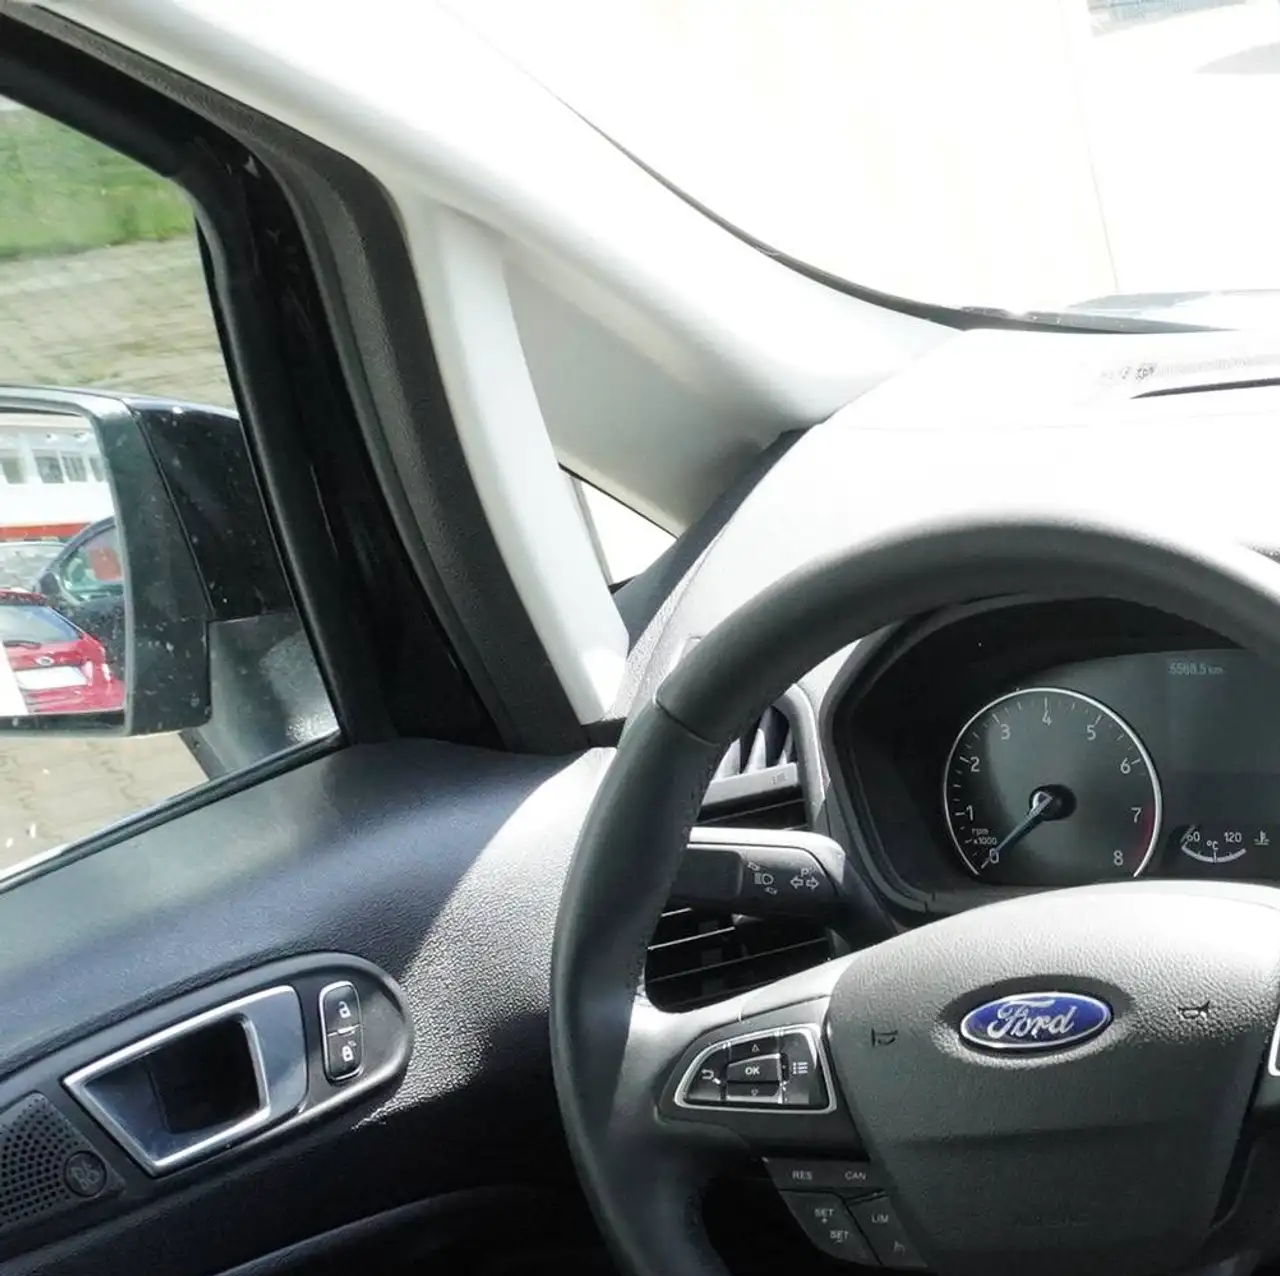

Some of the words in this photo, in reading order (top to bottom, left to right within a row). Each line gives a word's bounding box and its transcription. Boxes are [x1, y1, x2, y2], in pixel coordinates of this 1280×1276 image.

[1042, 710, 1052, 726] 4
[1000, 724, 1011, 739] 3
[1086, 725, 1097, 740] 5
[970, 757, 980, 772] 2
[1120, 760, 1131, 774] 6
[966, 805, 974, 820] 1
[1131, 807, 1142, 822] 7
[1223, 832, 1242, 843] 120
[989, 848, 1000, 864] 0
[1113, 850, 1124, 866] 8
[987, 999, 1078, 1039] Ford
[745, 1066, 760, 1075] OK
[792, 1171, 813, 1180] RES
[844, 1171, 867, 1180] CAN
[814, 1208, 834, 1217] SET
[829, 1230, 849, 1240] SET
